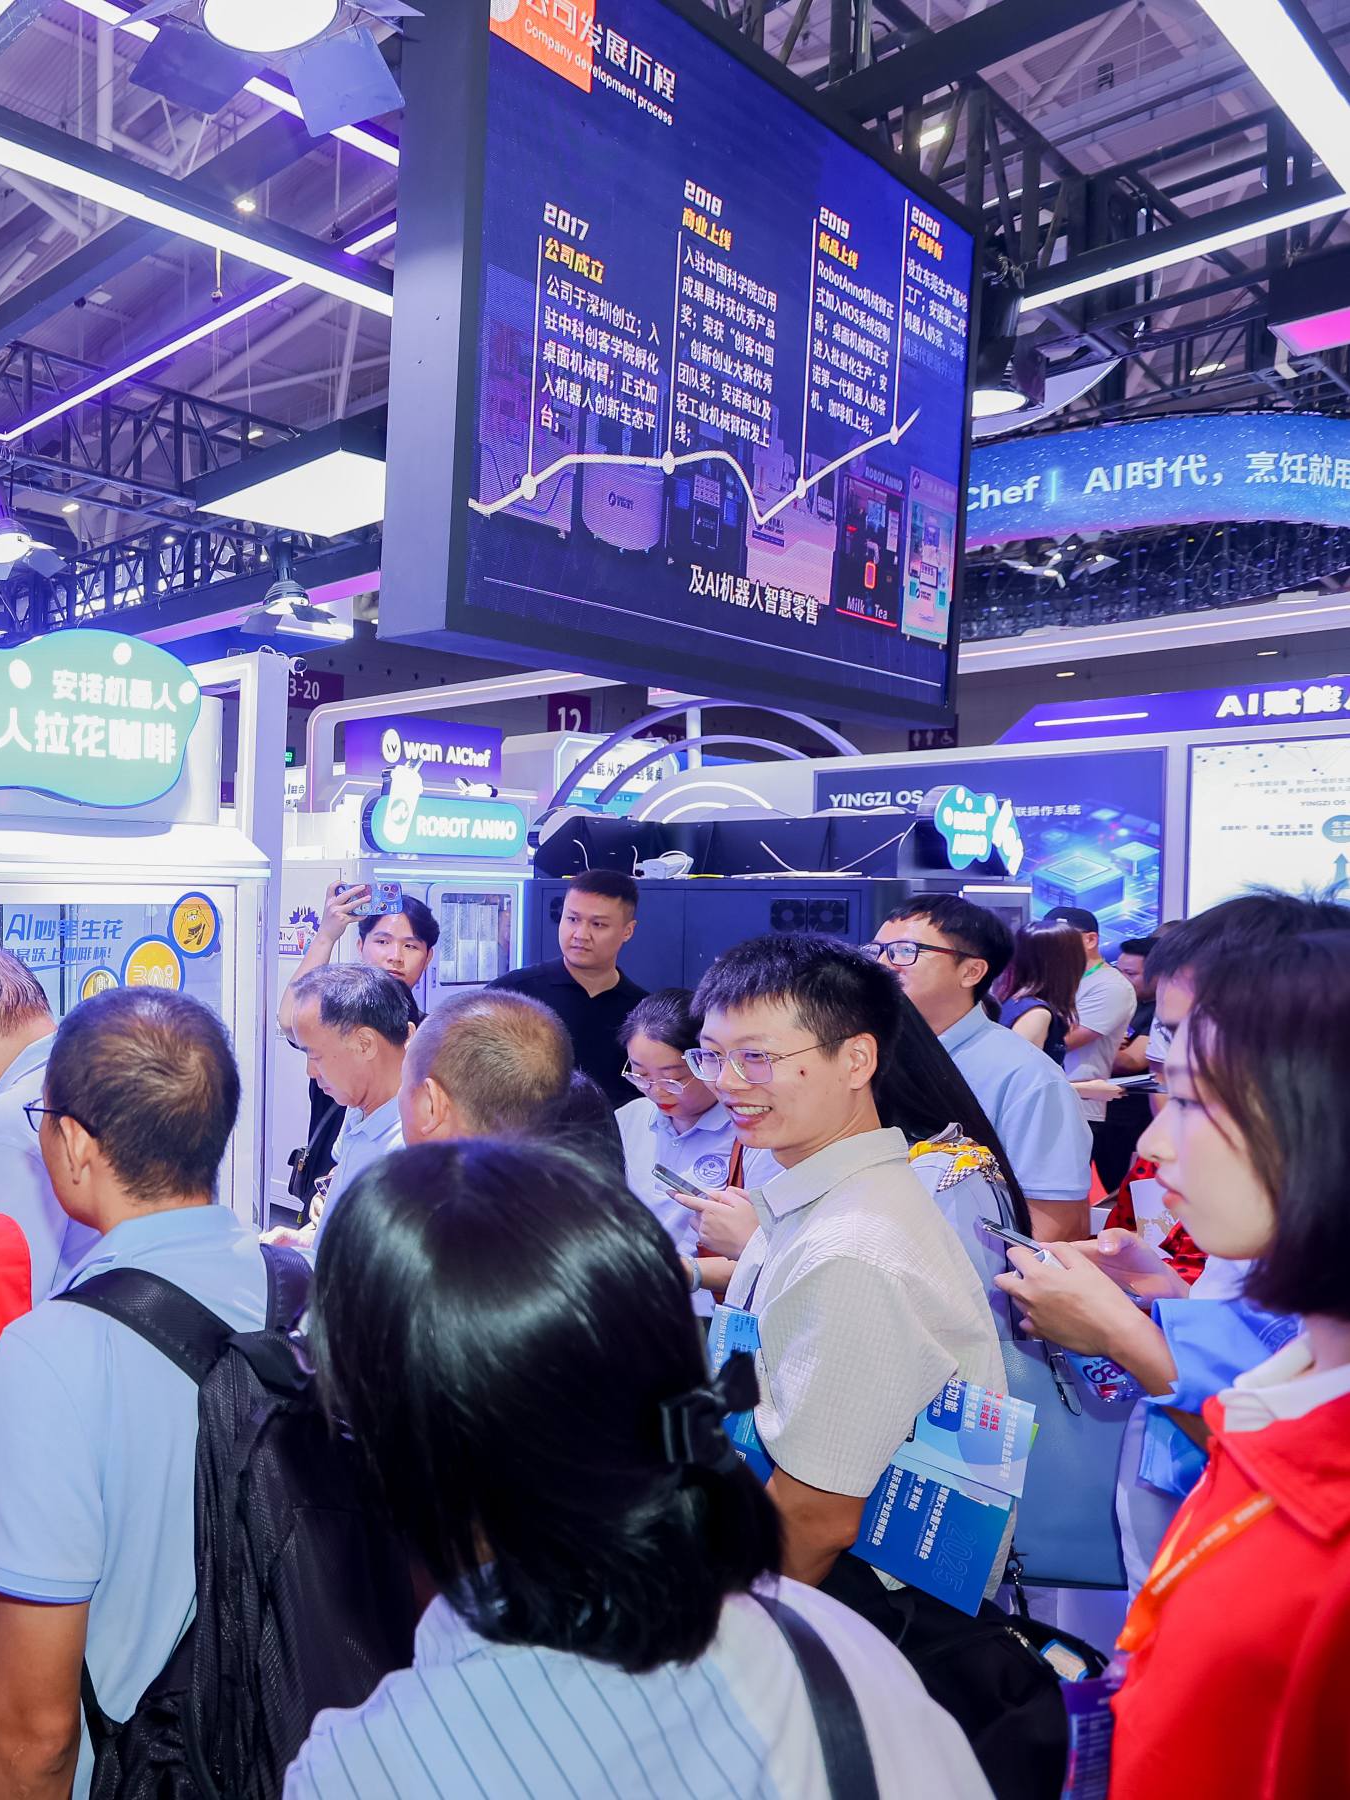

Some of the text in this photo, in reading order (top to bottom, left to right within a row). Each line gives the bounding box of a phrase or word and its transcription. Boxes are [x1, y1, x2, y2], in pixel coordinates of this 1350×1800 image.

[524, 18, 673, 126] Company development process
[684, 179, 723, 218] 2018
[543, 201, 590, 241] 2017
[682, 206, 732, 252] 商业上线
[819, 206, 851, 240] 2019
[910, 205, 941, 239] 2020
[544, 236, 605, 285] 公司成立
[818, 230, 859, 271] 新品上线
[683, 244, 777, 313] 入驻中国科学院应用
[681, 274, 776, 341] 成果展并获优秀产品
[543, 304, 659, 376] 驻中科创客学院孵化
[540, 371, 656, 434] 入机器人创新生态平
[675, 390, 770, 449] 轻工业机械臂研发上
[688, 563, 819, 626] 及AI机器人智慧零售
[874, 603, 888, 620] Tea
[52, 669, 178, 713] 安诺机器人
[1215, 684, 1350, 718] AI赋能
[557, 706, 582, 732] 12
[403, 741, 443, 763] wan
[829, 790, 924, 808] YINGZI OS
[416, 815, 518, 841] ROBOT ANNO
[931, 1520, 978, 1592] 2025
